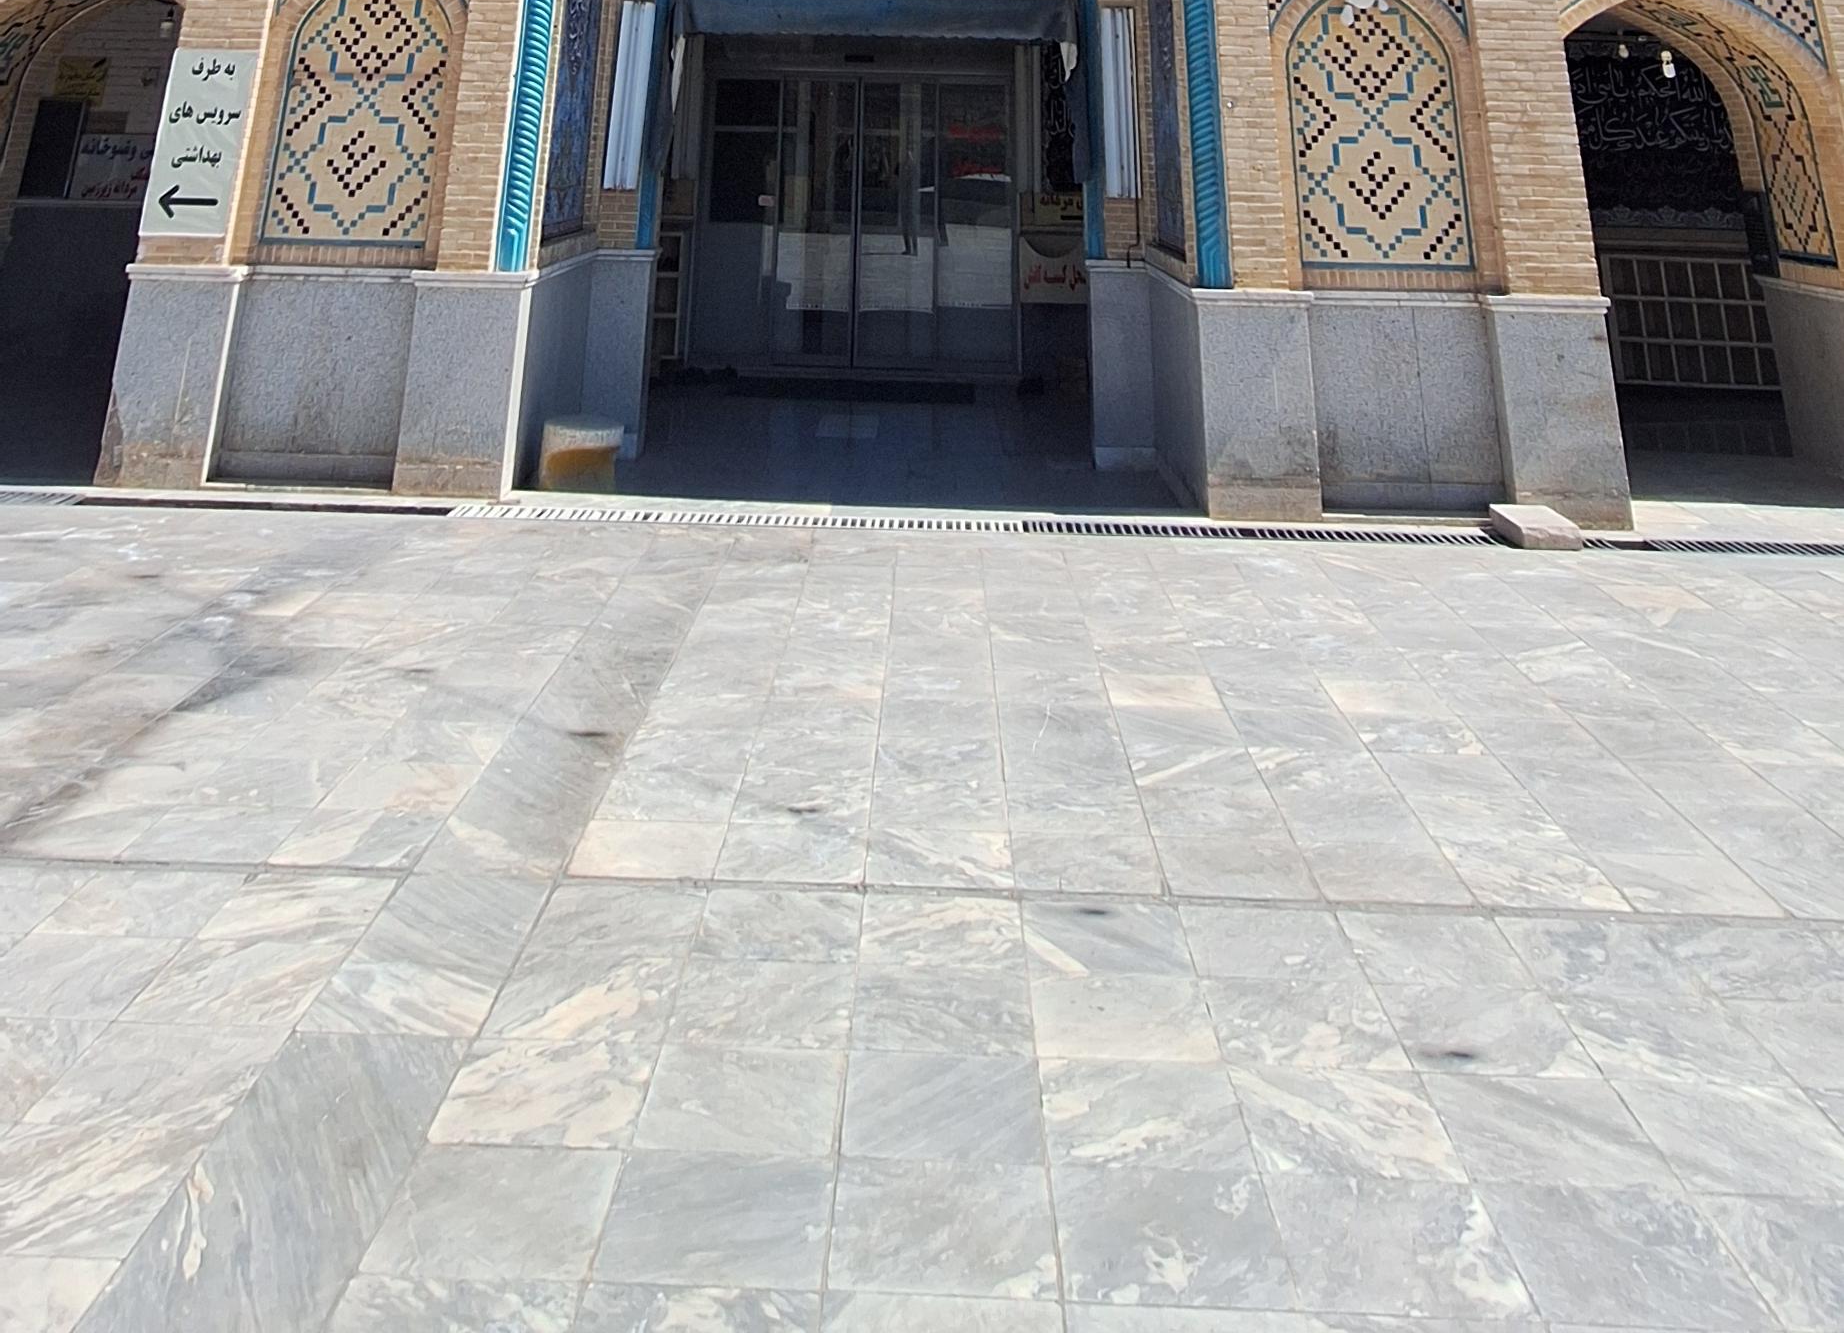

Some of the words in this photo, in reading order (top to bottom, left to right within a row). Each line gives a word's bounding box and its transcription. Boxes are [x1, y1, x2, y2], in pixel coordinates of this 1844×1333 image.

[191, 57, 222, 82] طرف
[223, 62, 236, 81] به
[168, 100, 194, 124] های
[196, 106, 242, 126] سرویس
[170, 144, 222, 169] بهداشتی
